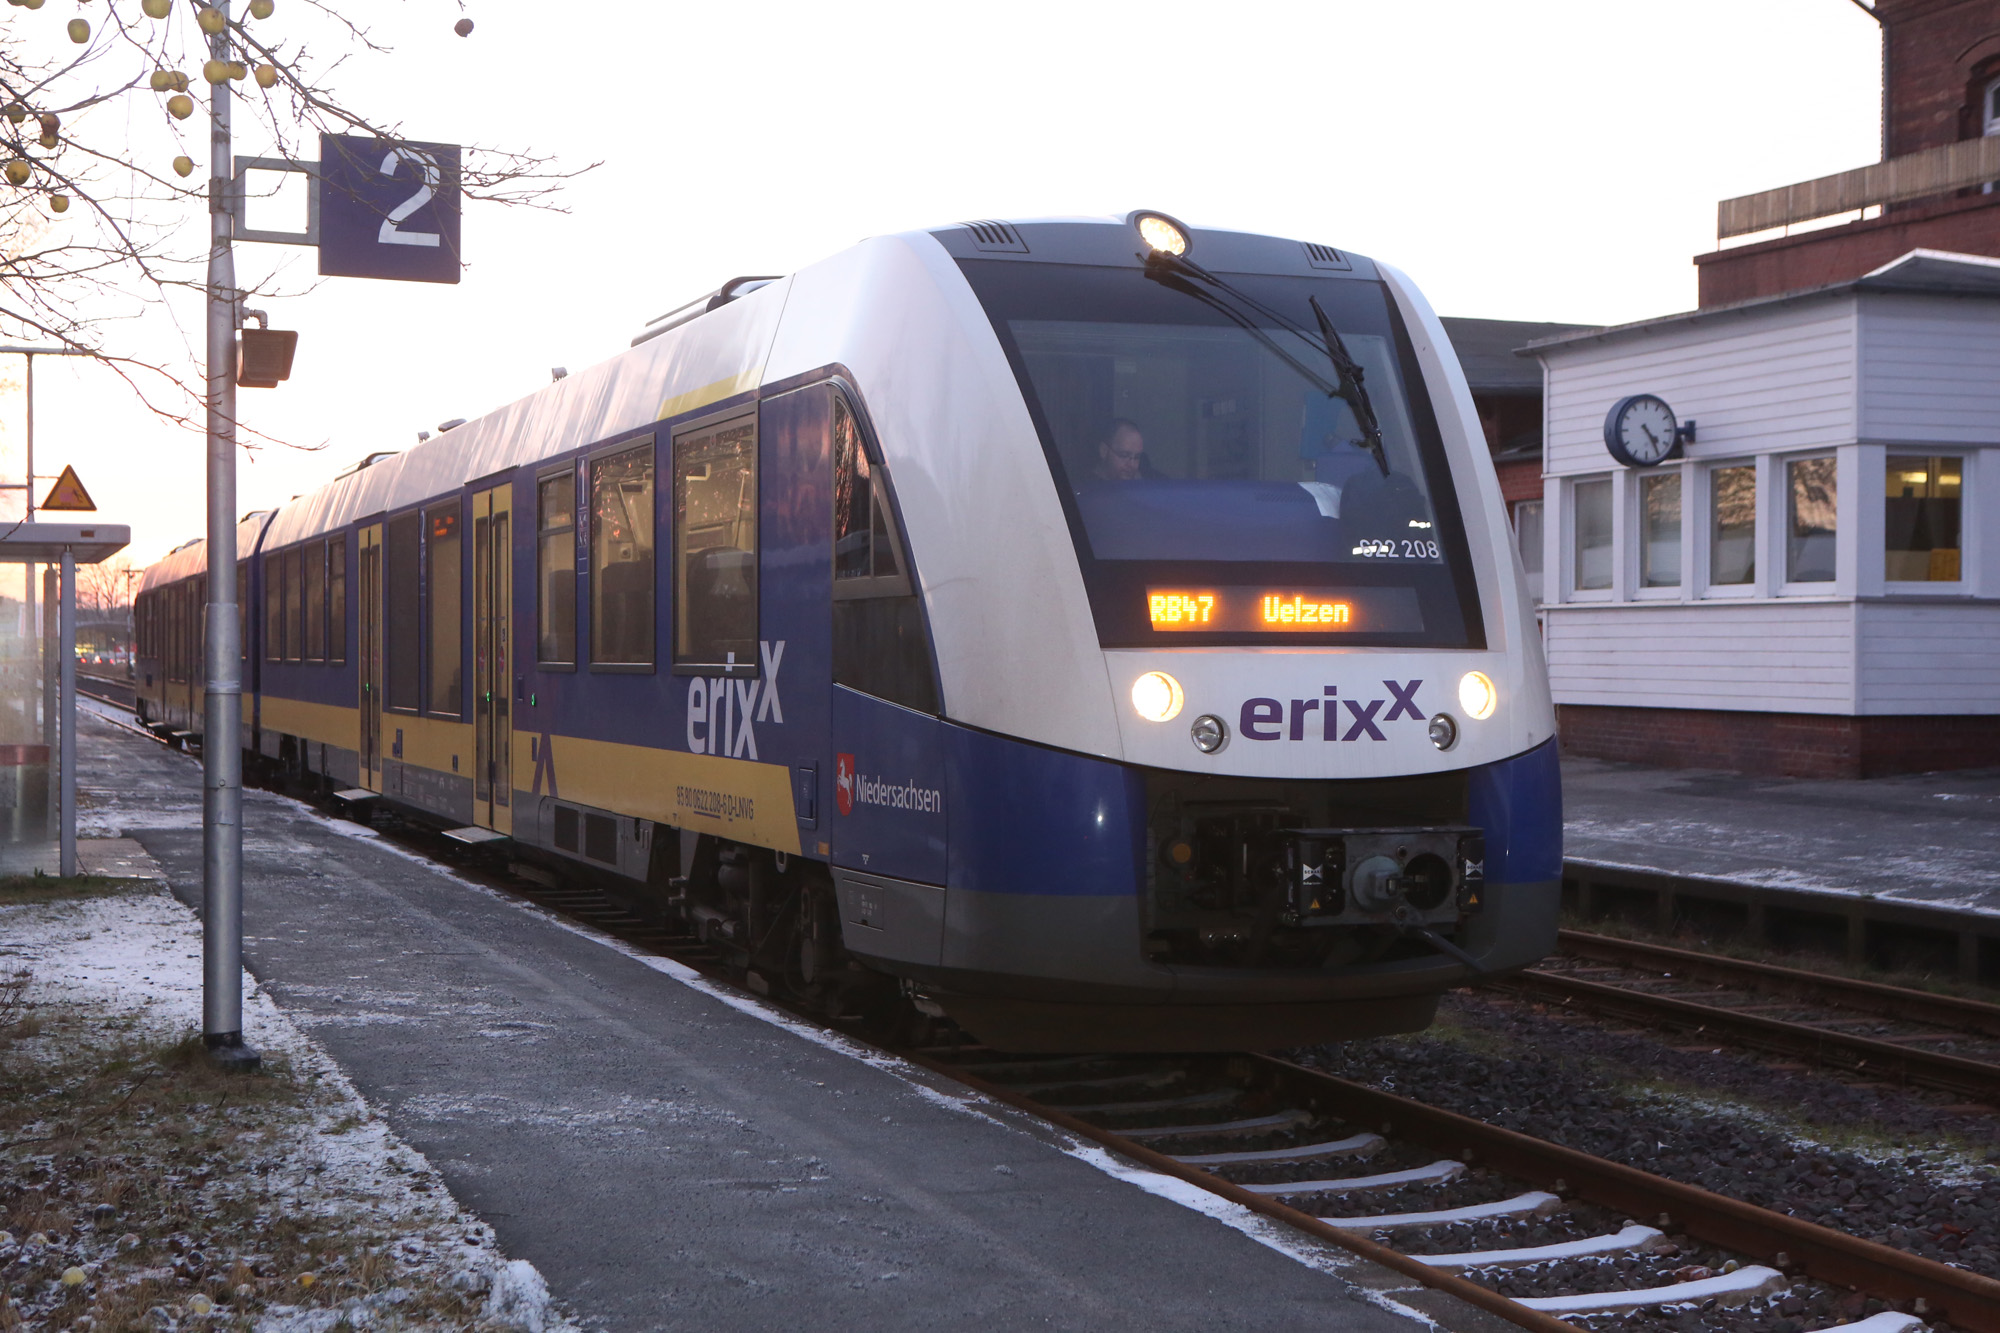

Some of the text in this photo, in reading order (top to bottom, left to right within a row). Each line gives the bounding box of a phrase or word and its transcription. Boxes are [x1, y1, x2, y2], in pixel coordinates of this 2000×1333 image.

[378, 146, 440, 247] 2
[1401, 539, 1439, 558] 208
[1150, 595, 1349, 622] RB47 Uelzen
[687, 640, 786, 760] erixx
[1239, 679, 1427, 742] erixx
[856, 773, 941, 813] Niedersachsen
